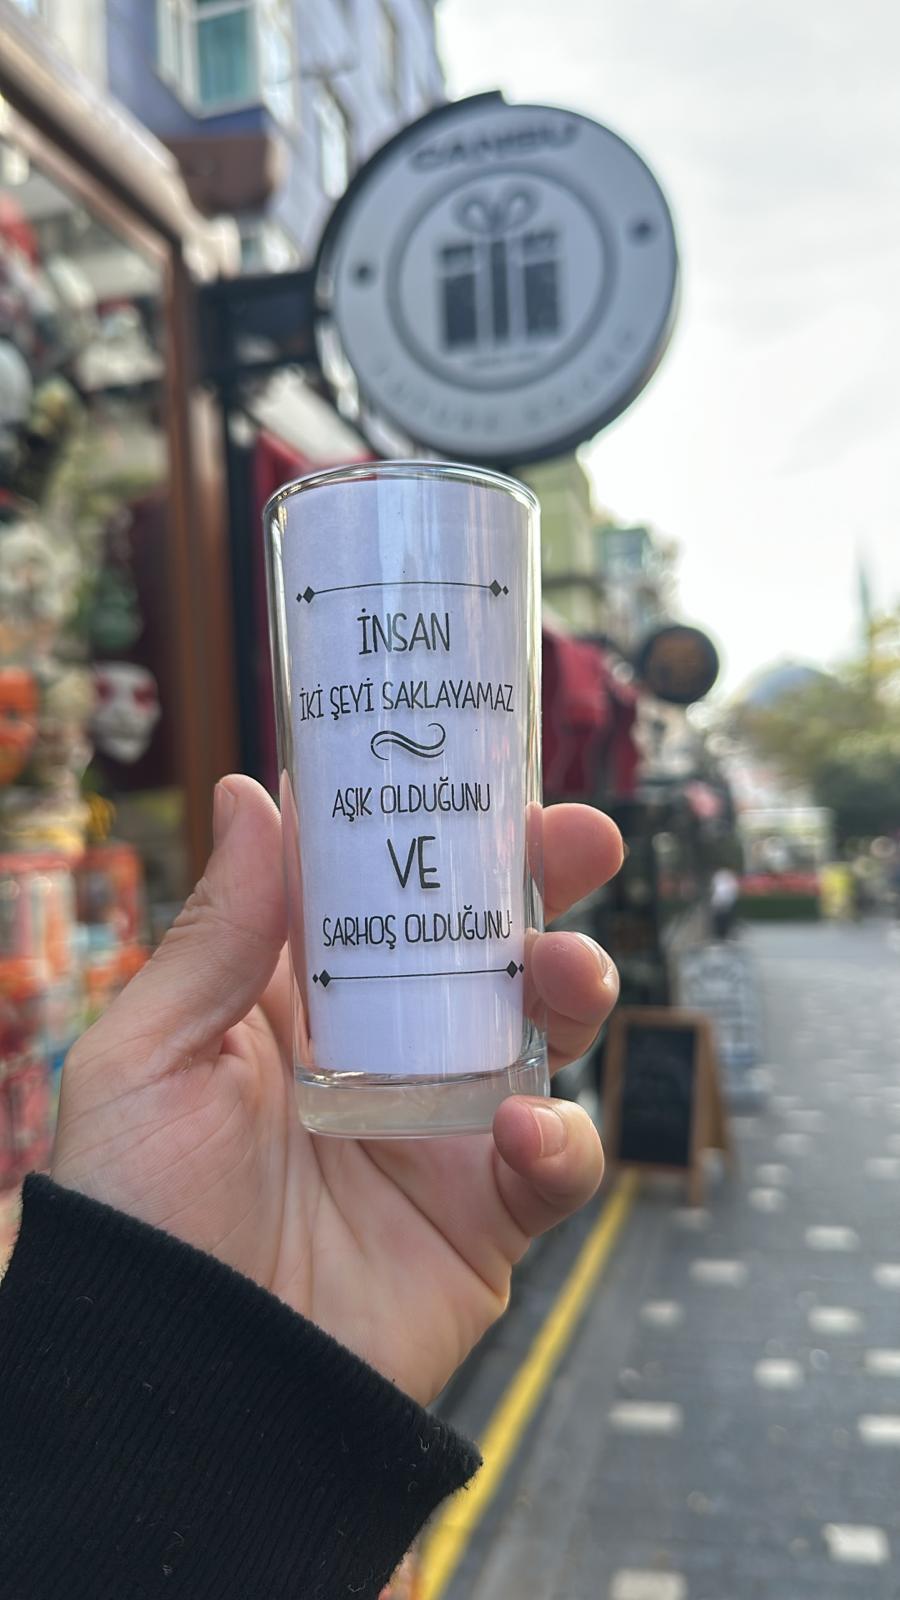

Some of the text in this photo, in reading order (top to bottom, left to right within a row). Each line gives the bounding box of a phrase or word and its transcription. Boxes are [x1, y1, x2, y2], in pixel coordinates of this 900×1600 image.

[357, 608, 451, 655] İNSAN
[299, 677, 515, 721] İKİ ŞEYİ SAKLAYAMAZ
[332, 776, 491, 823] AŞIK OLDUĞUNU
[386, 835, 441, 889] VE
[322, 904, 511, 950] SARHOŞ OLDUĞUNU
